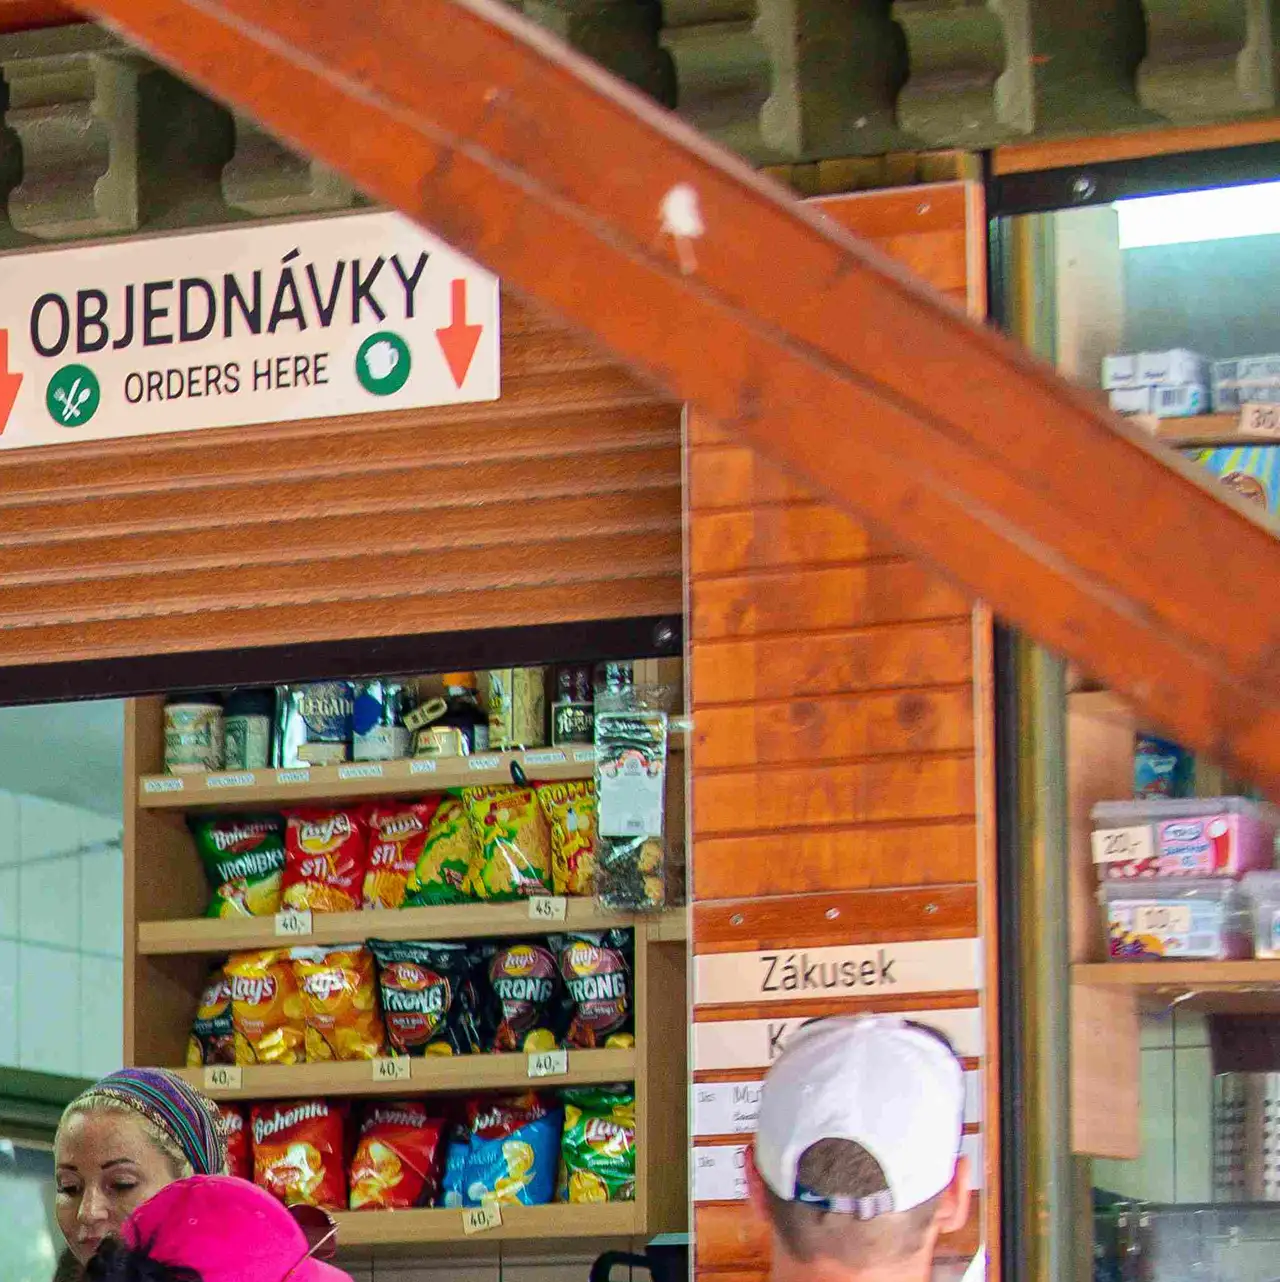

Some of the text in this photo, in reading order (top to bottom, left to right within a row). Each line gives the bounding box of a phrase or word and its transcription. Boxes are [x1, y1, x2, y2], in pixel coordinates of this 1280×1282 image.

[29, 247, 430, 357] OBJEDNÁVKY
[124, 352, 329, 404] ORDERS HERE
[535, 899, 560, 917] 45,-
[281, 913, 306, 933] 40,-
[760, 949, 897, 995] Zákusek
[379, 1061, 404, 1080] 40,-
[535, 1057, 560, 1073] 40,-
[212, 1070, 235, 1087] 40,-
[470, 1210, 494, 1227] 40,-
